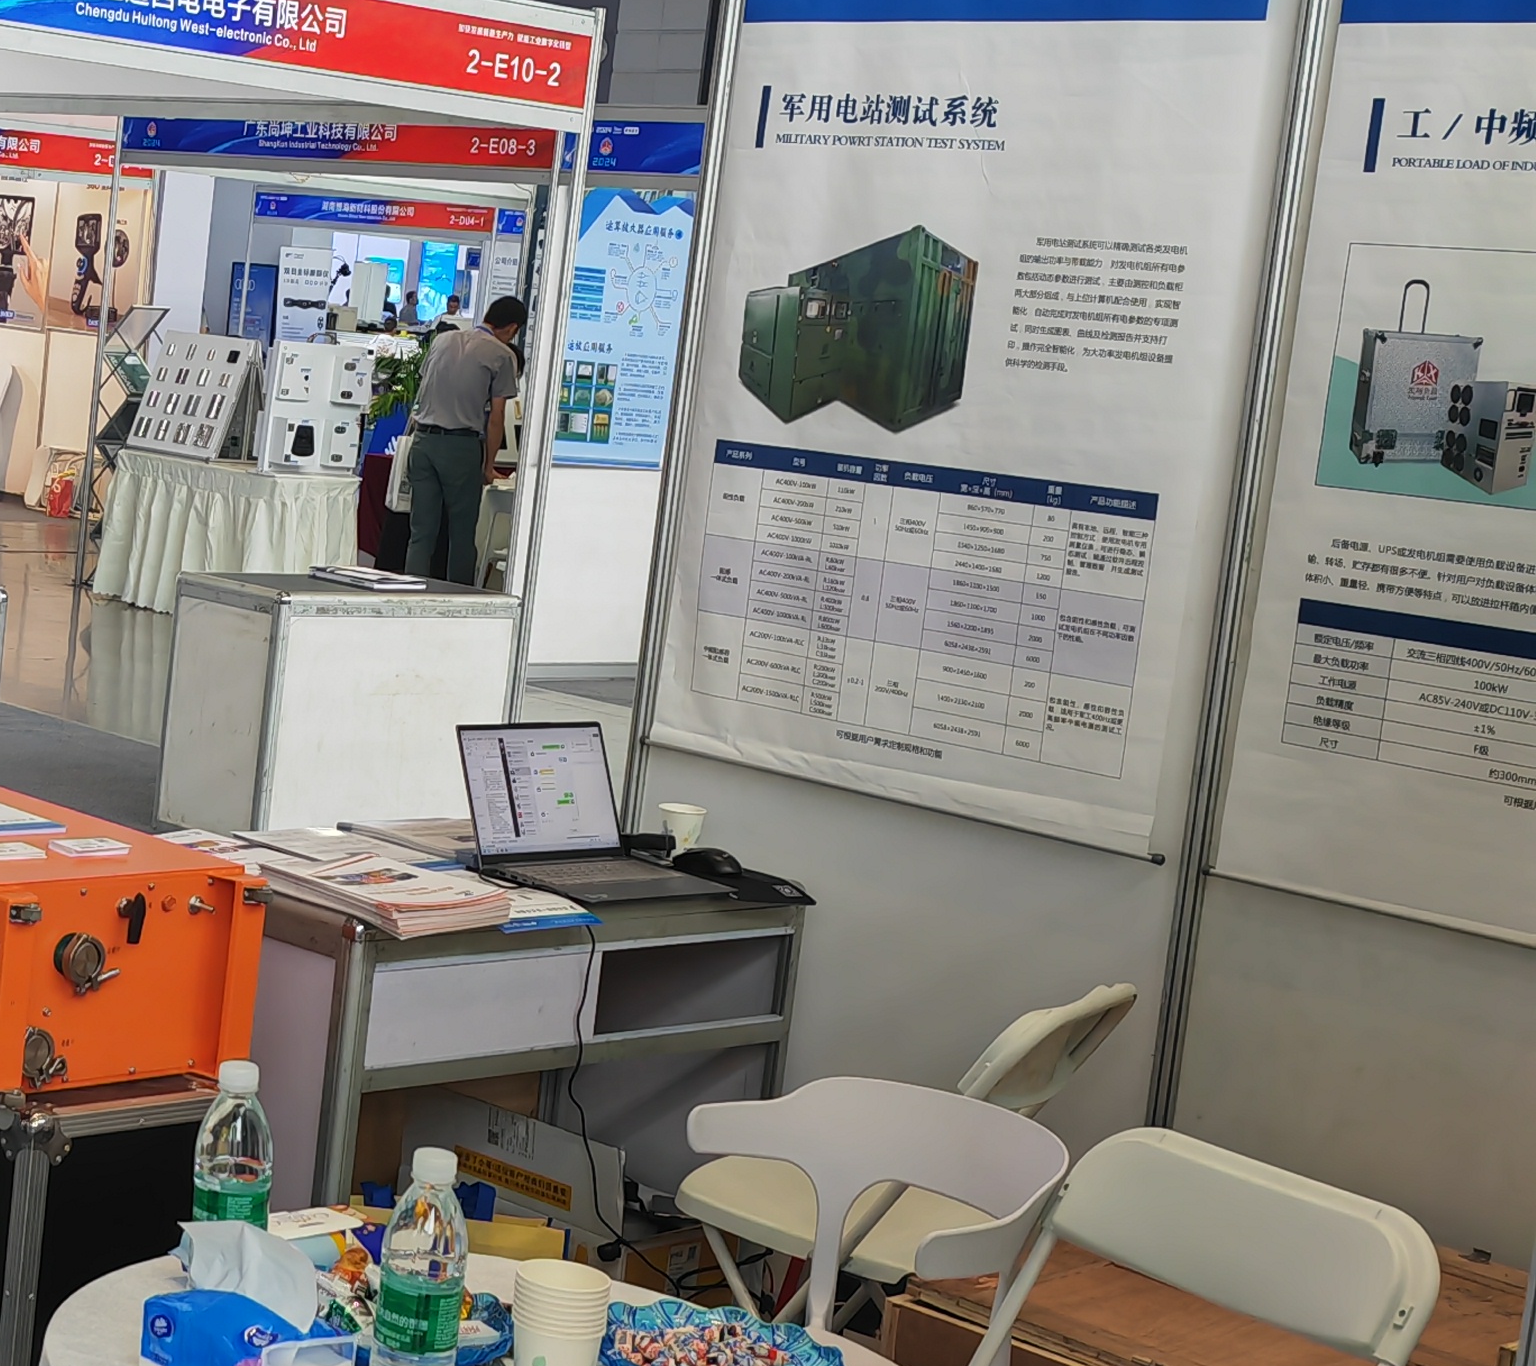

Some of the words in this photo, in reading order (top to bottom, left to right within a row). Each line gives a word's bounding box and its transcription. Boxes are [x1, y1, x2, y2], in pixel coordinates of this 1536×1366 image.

[75, 1, 130, 24] Chengdu
[180, 18, 273, 46] West-electronic
[298, 37, 317, 53] Ltd
[466, 48, 562, 87] 2-E10-2
[779, 92, 1000, 128] 军用电站测试系统
[242, 119, 398, 142] 广东尚坤工业科技有限公司
[469, 137, 536, 156] 2-E08-3
[775, 133, 832, 146] MILITARY
[873, 135, 925, 148] STATION
[925, 137, 957, 149] TEST
[957, 138, 1006, 151] SYSTEM
[592, 156, 617, 167] 2024
[1391, 156, 1455, 170] PORTABLE
[1455, 158, 1491, 171] LOAD
[1492, 160, 1511, 171] OF
[904, 471, 934, 484] 负载电压
[982, 476, 997, 487] 尺寸
[1313, 653, 1370, 672] 最大负载功率
[1473, 679, 1509, 695] 100kW
[1315, 695, 1354, 712] 负载精度
[1473, 723, 1496, 736] ±1%
[1318, 736, 1339, 750] 尺寸
[1473, 743, 1490, 757] F级
